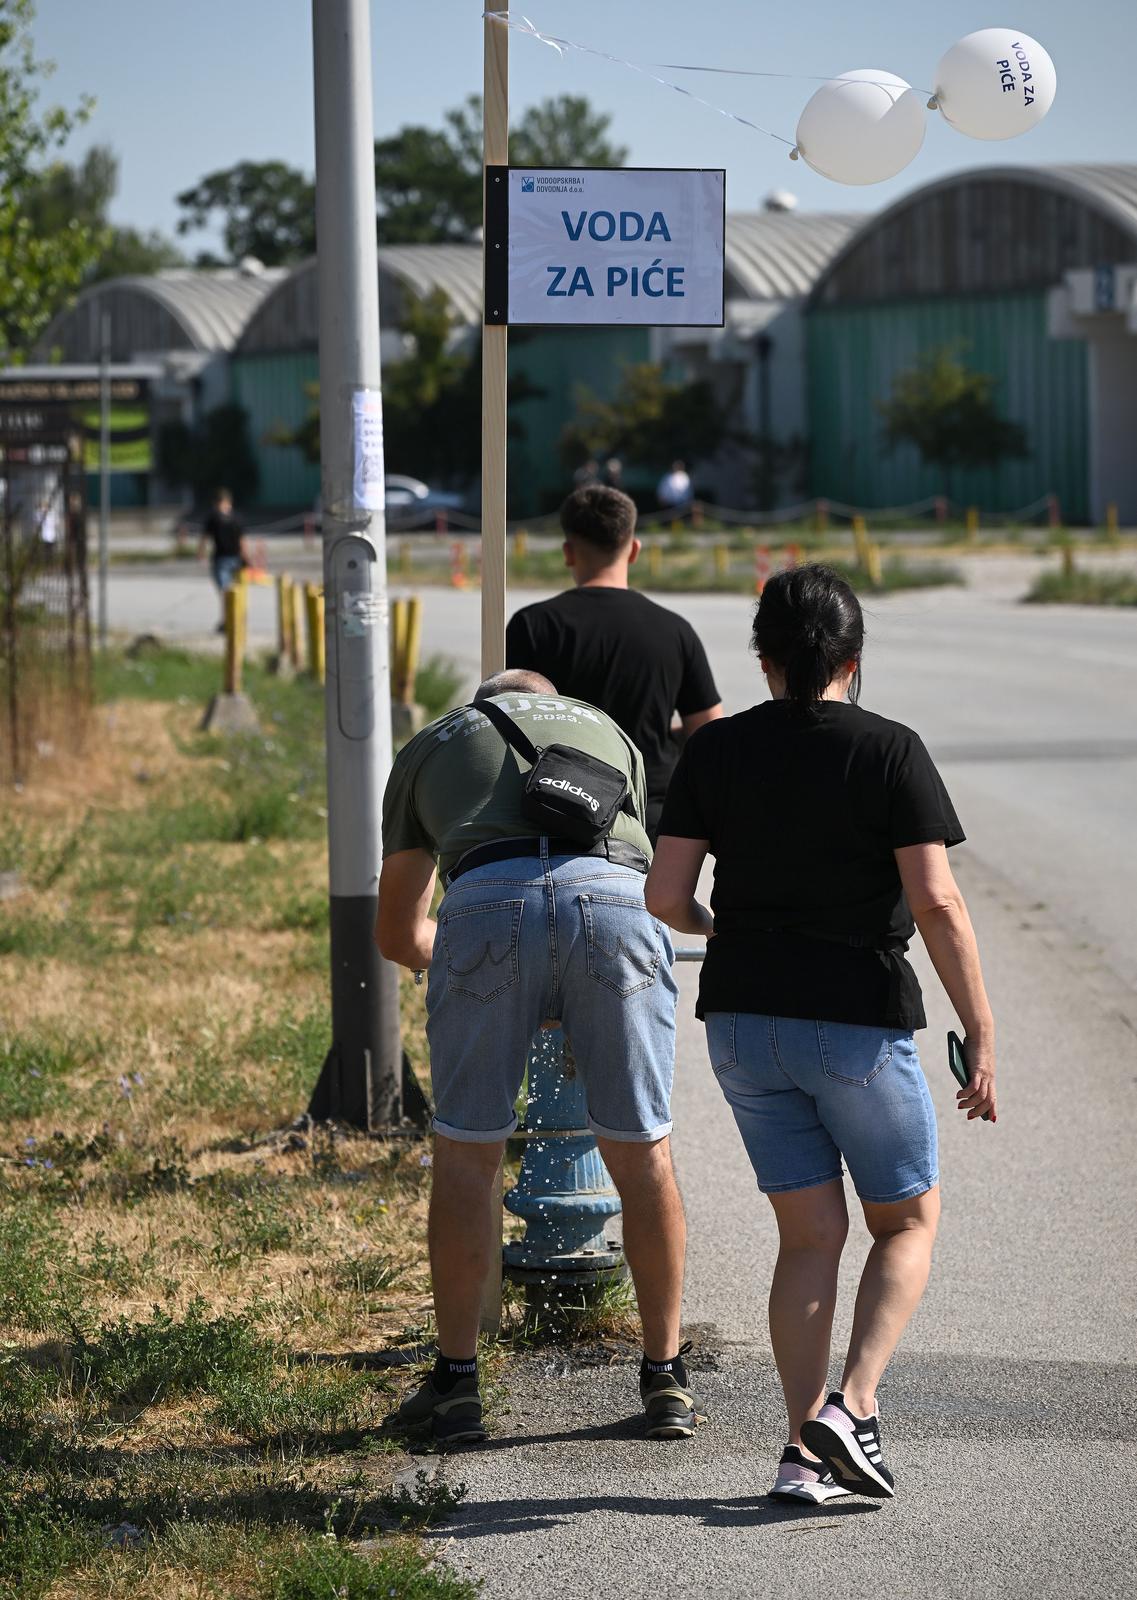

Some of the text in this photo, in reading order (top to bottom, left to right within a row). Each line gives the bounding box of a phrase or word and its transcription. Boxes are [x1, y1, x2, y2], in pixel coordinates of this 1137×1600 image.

[996, 59, 1016, 92] PIĆE
[1011, 42, 1034, 107] VODA ZA
[536, 185, 568, 193] ODVODNJA
[561, 211, 672, 242] VODA
[546, 258, 685, 297] ZA PIĆE
[538, 777, 600, 812] adidas
